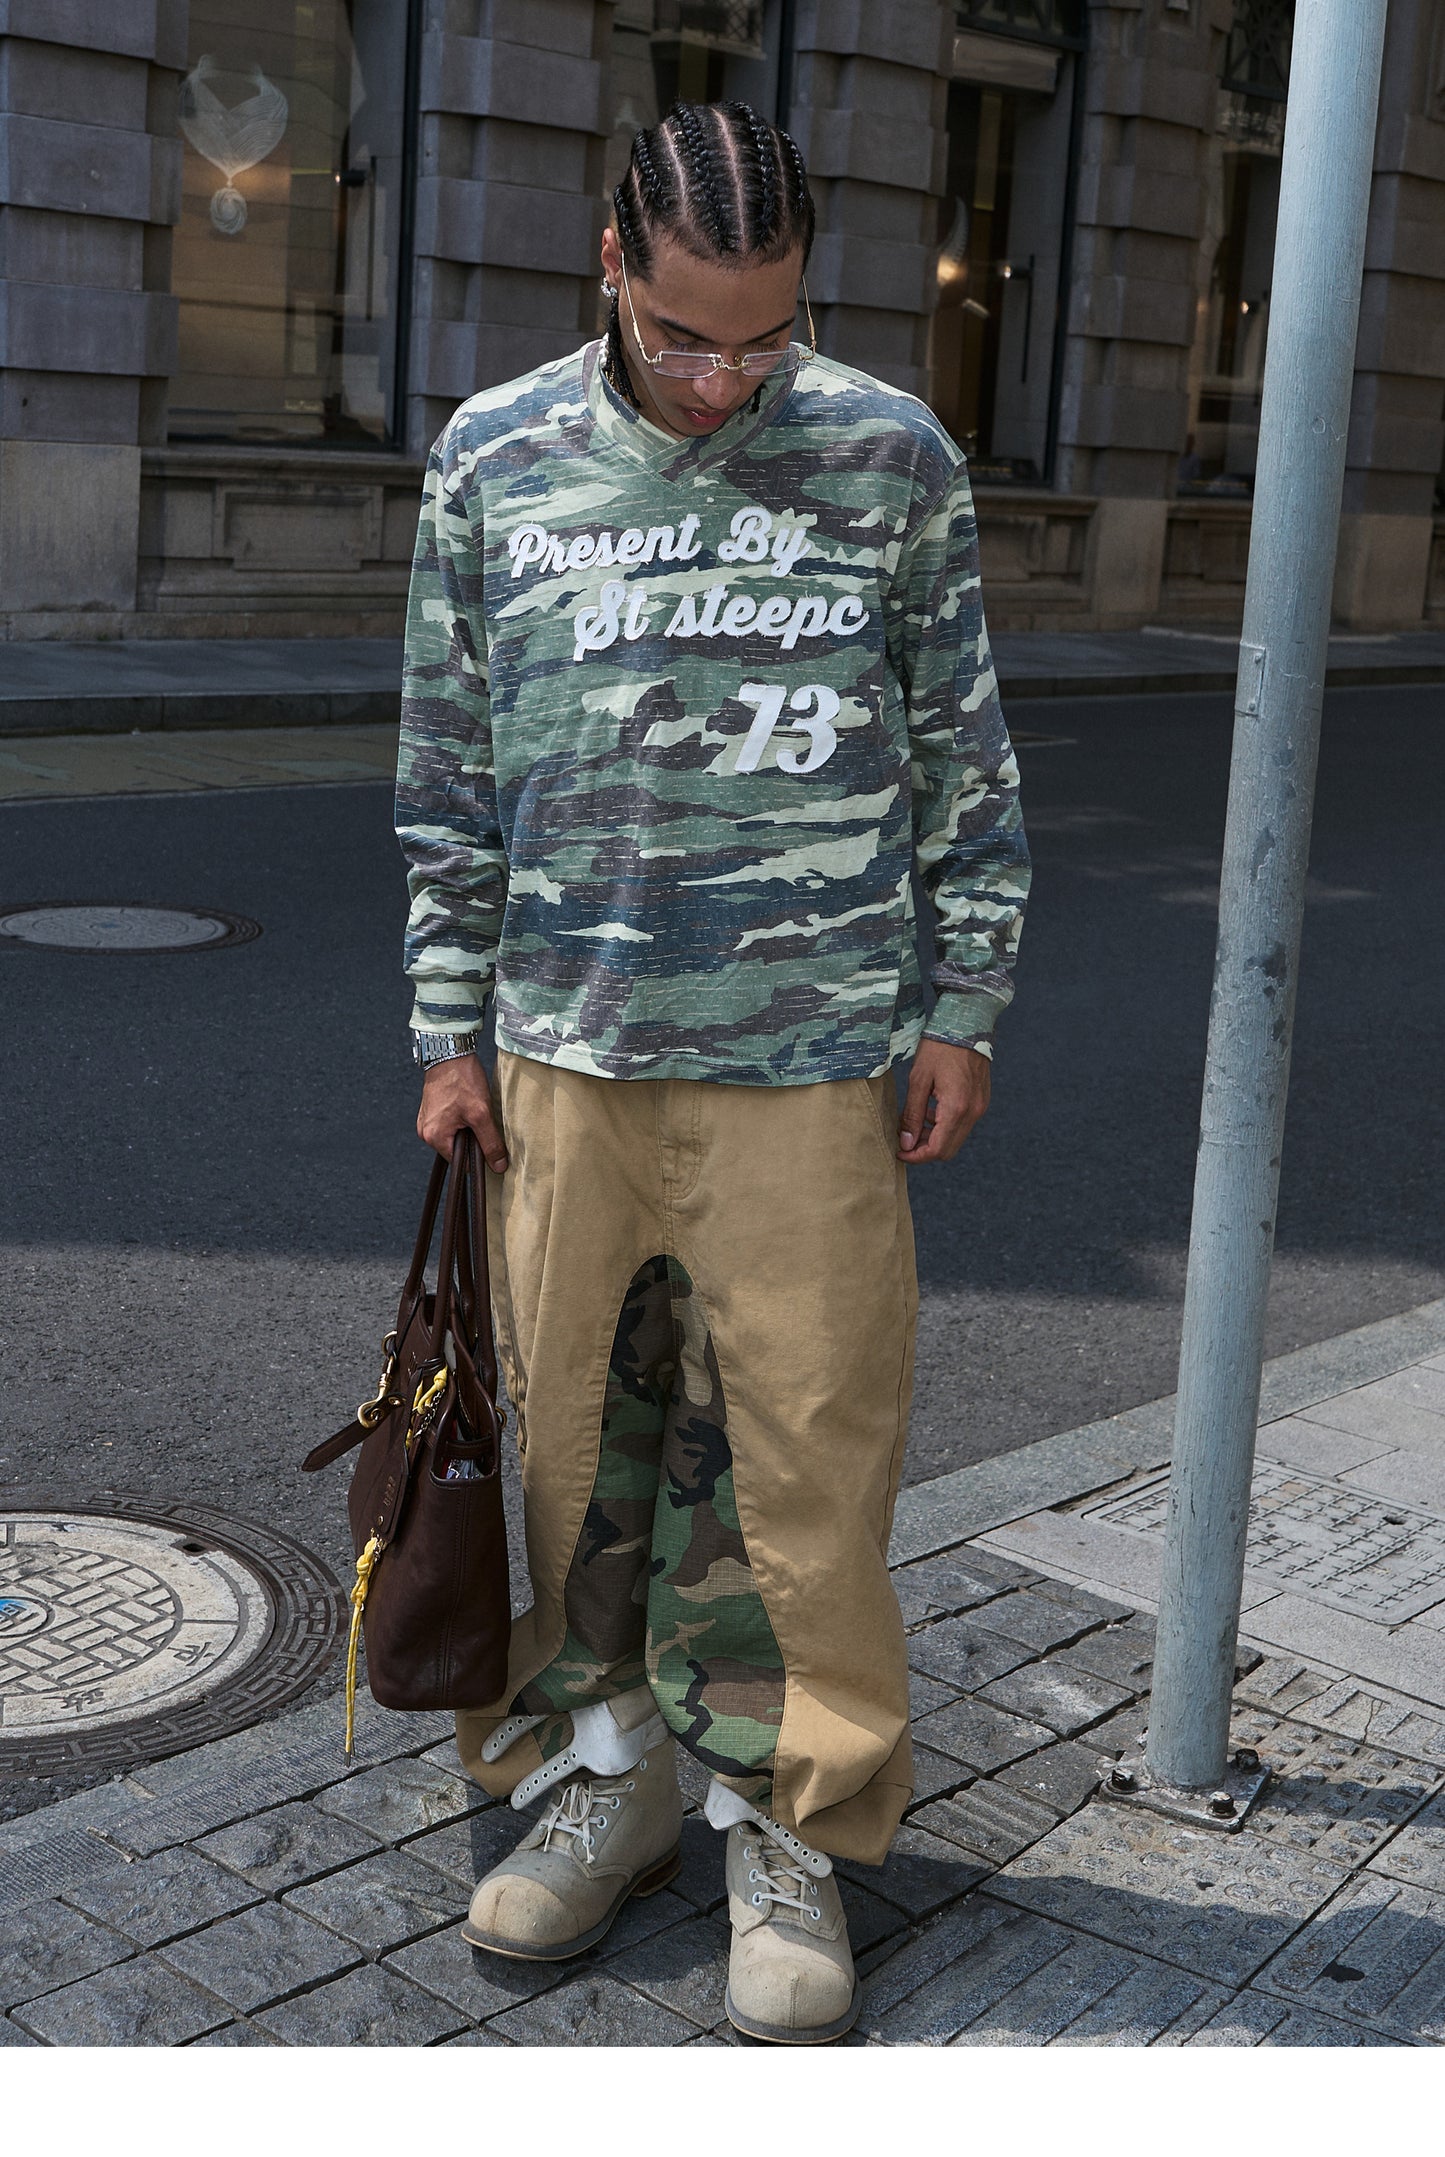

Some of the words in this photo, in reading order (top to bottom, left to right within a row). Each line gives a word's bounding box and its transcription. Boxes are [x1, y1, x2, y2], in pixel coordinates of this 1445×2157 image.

[507, 513, 703, 579] Present
[718, 506, 812, 578] By
[573, 580, 651, 662] St
[665, 584, 870, 650] steepc
[734, 682, 842, 775] 73
